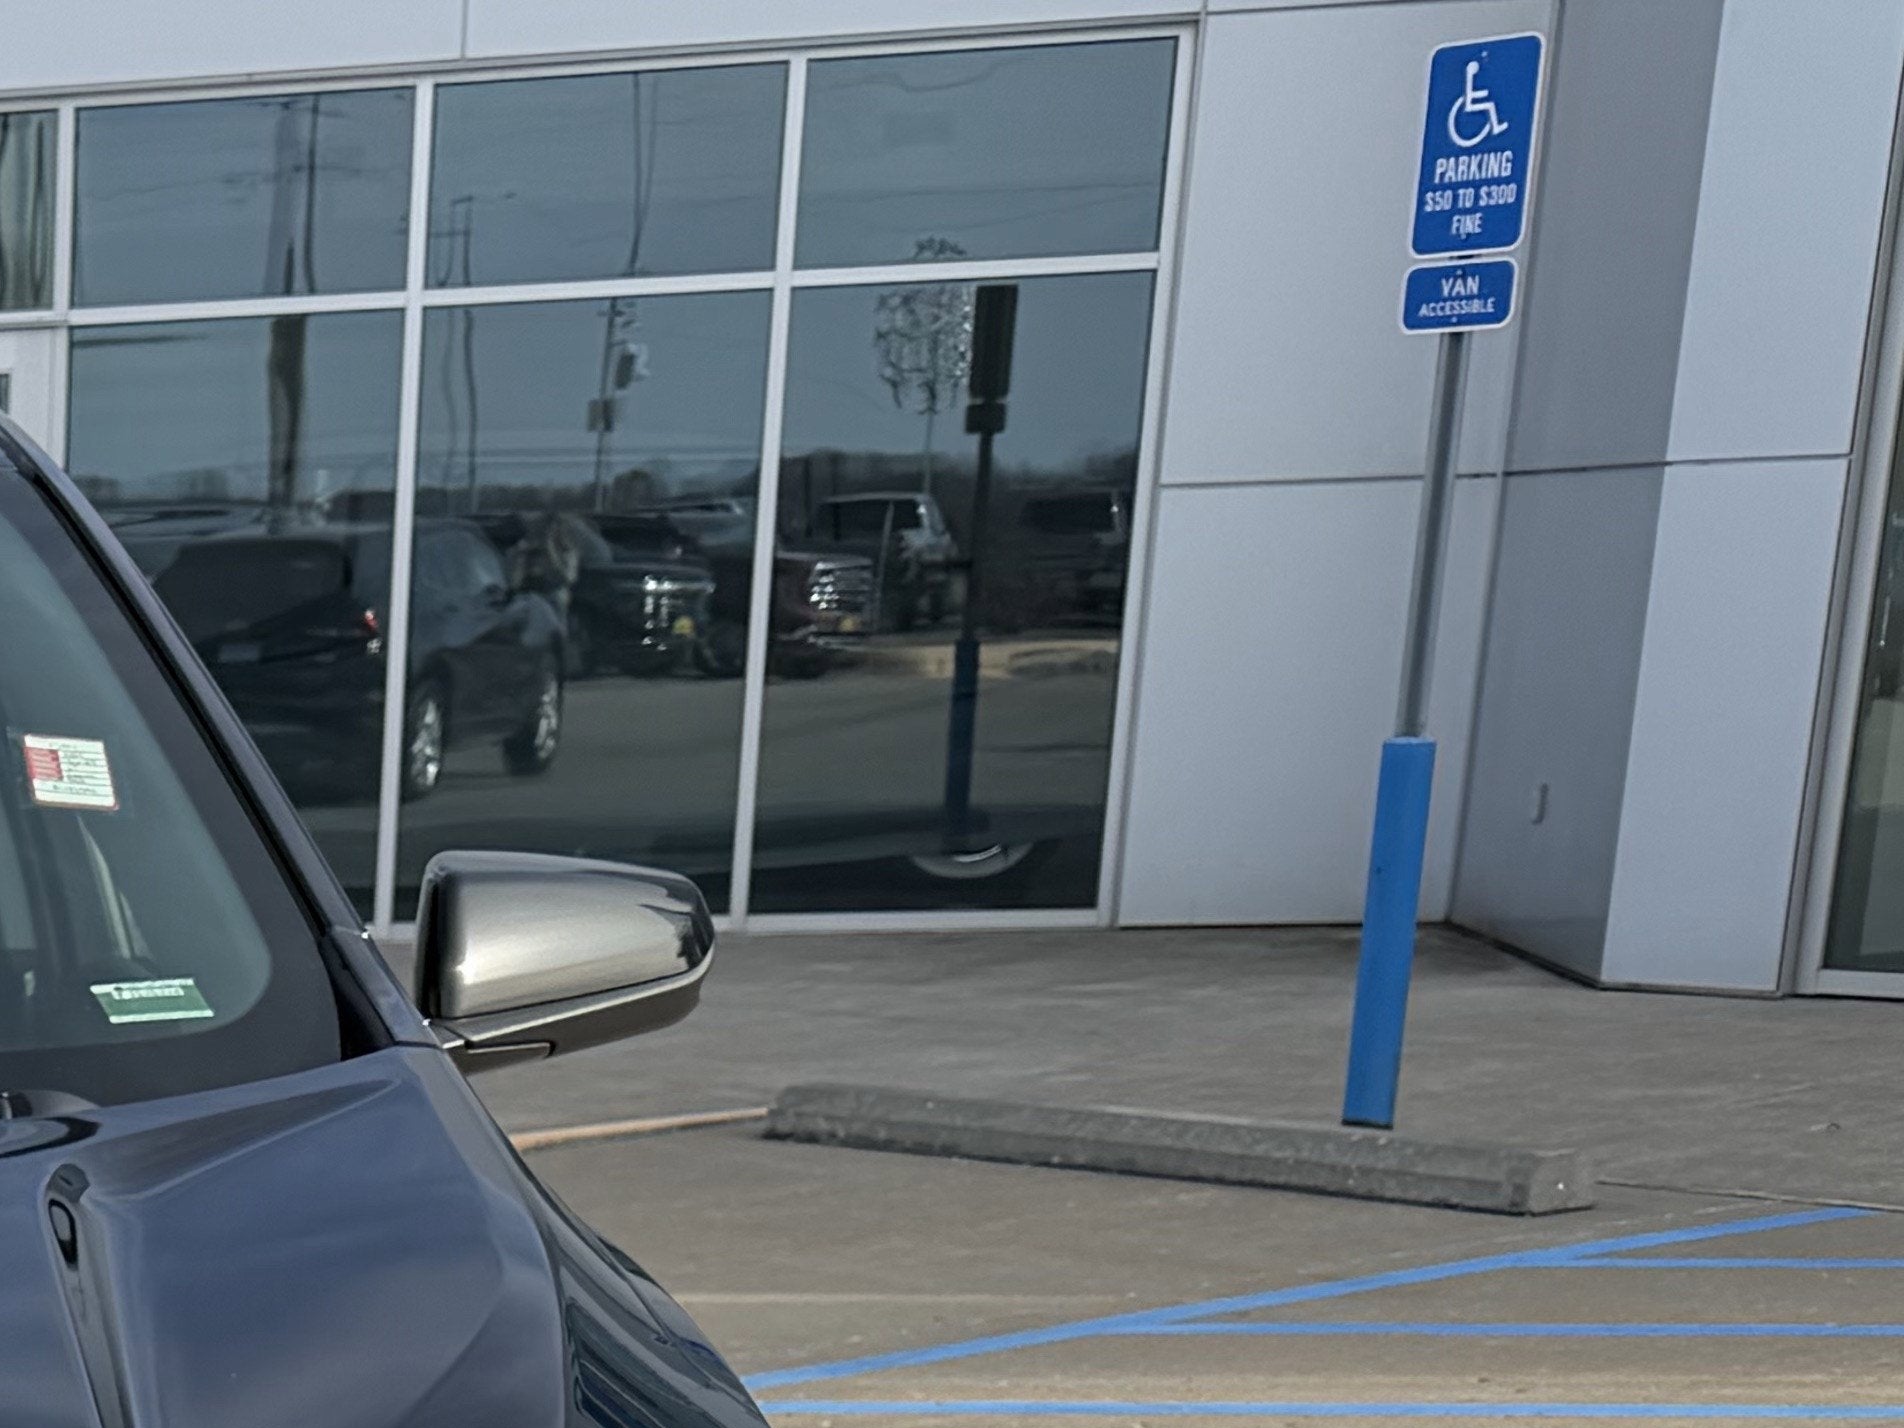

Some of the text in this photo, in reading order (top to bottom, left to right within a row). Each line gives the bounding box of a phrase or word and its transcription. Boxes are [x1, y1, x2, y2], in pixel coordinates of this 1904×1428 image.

[1434, 150, 1513, 184] PARKING
[1424, 183, 1517, 212] $50 TO $300
[1451, 213, 1483, 235] FINE
[1442, 275, 1479, 297] VAN
[1418, 297, 1496, 317] ACCESSIBLE
